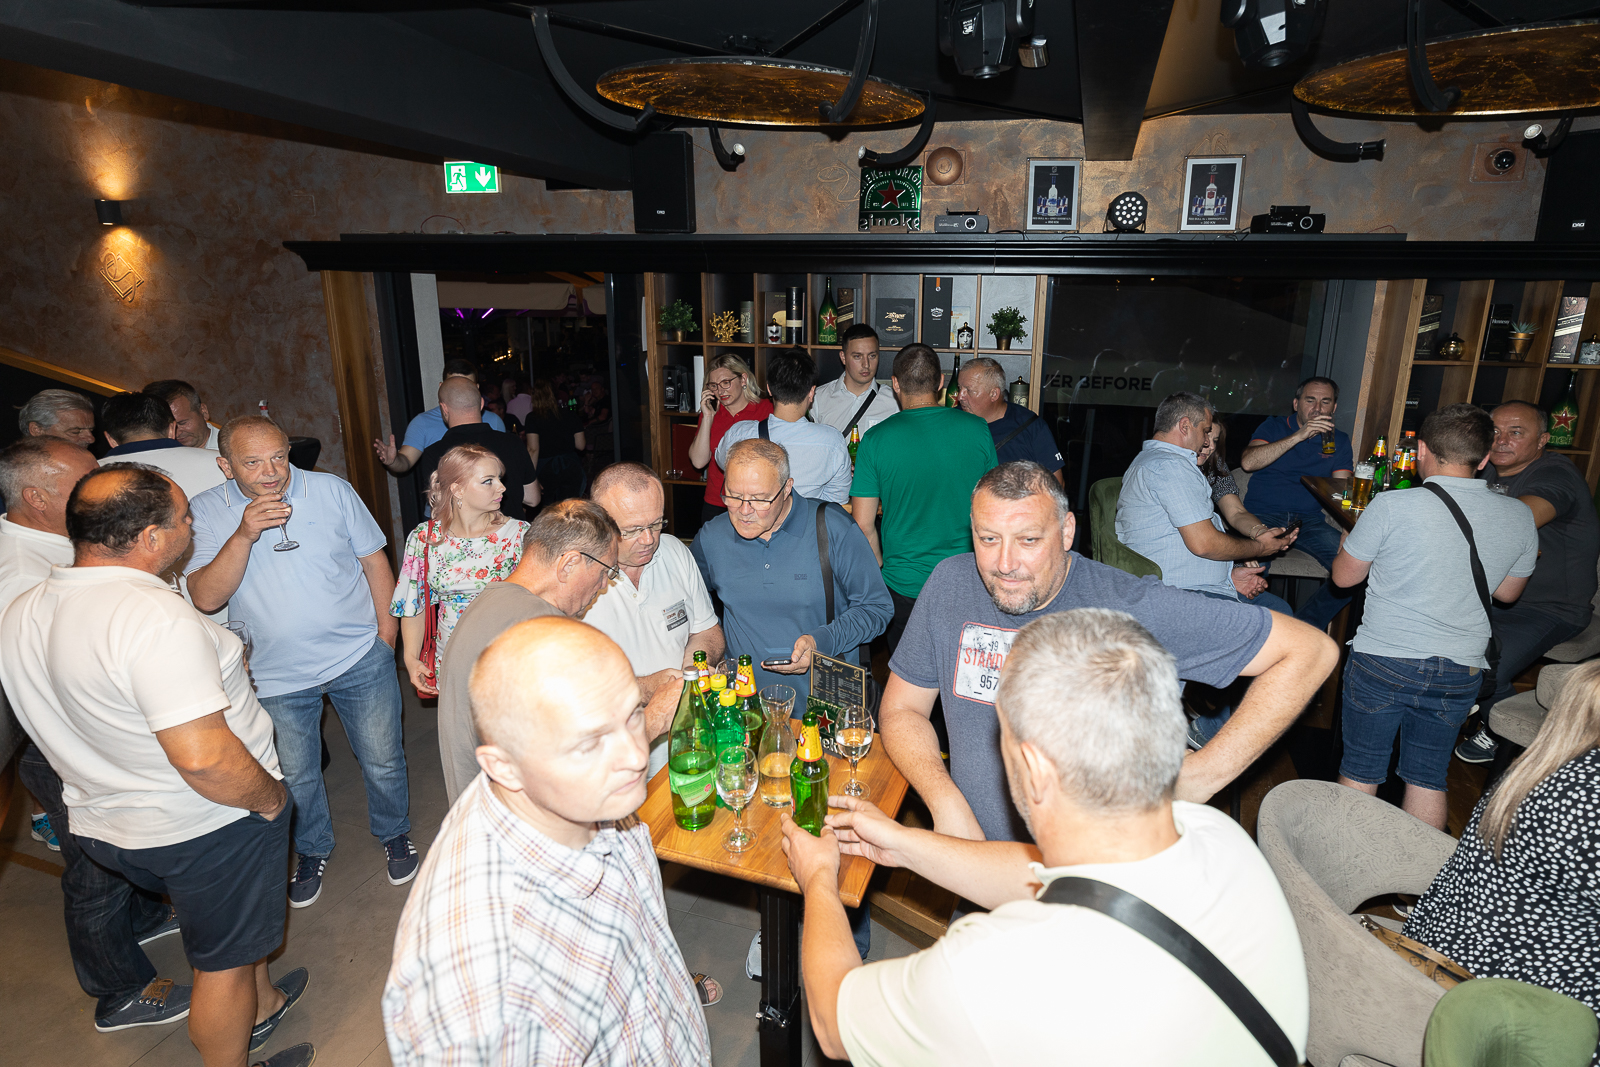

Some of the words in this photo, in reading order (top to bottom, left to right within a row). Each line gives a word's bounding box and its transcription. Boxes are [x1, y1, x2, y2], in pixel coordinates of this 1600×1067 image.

[1079, 375, 1153, 391] BEFORE
[964, 647, 1005, 671] STAND
[979, 674, 1000, 691] 957
